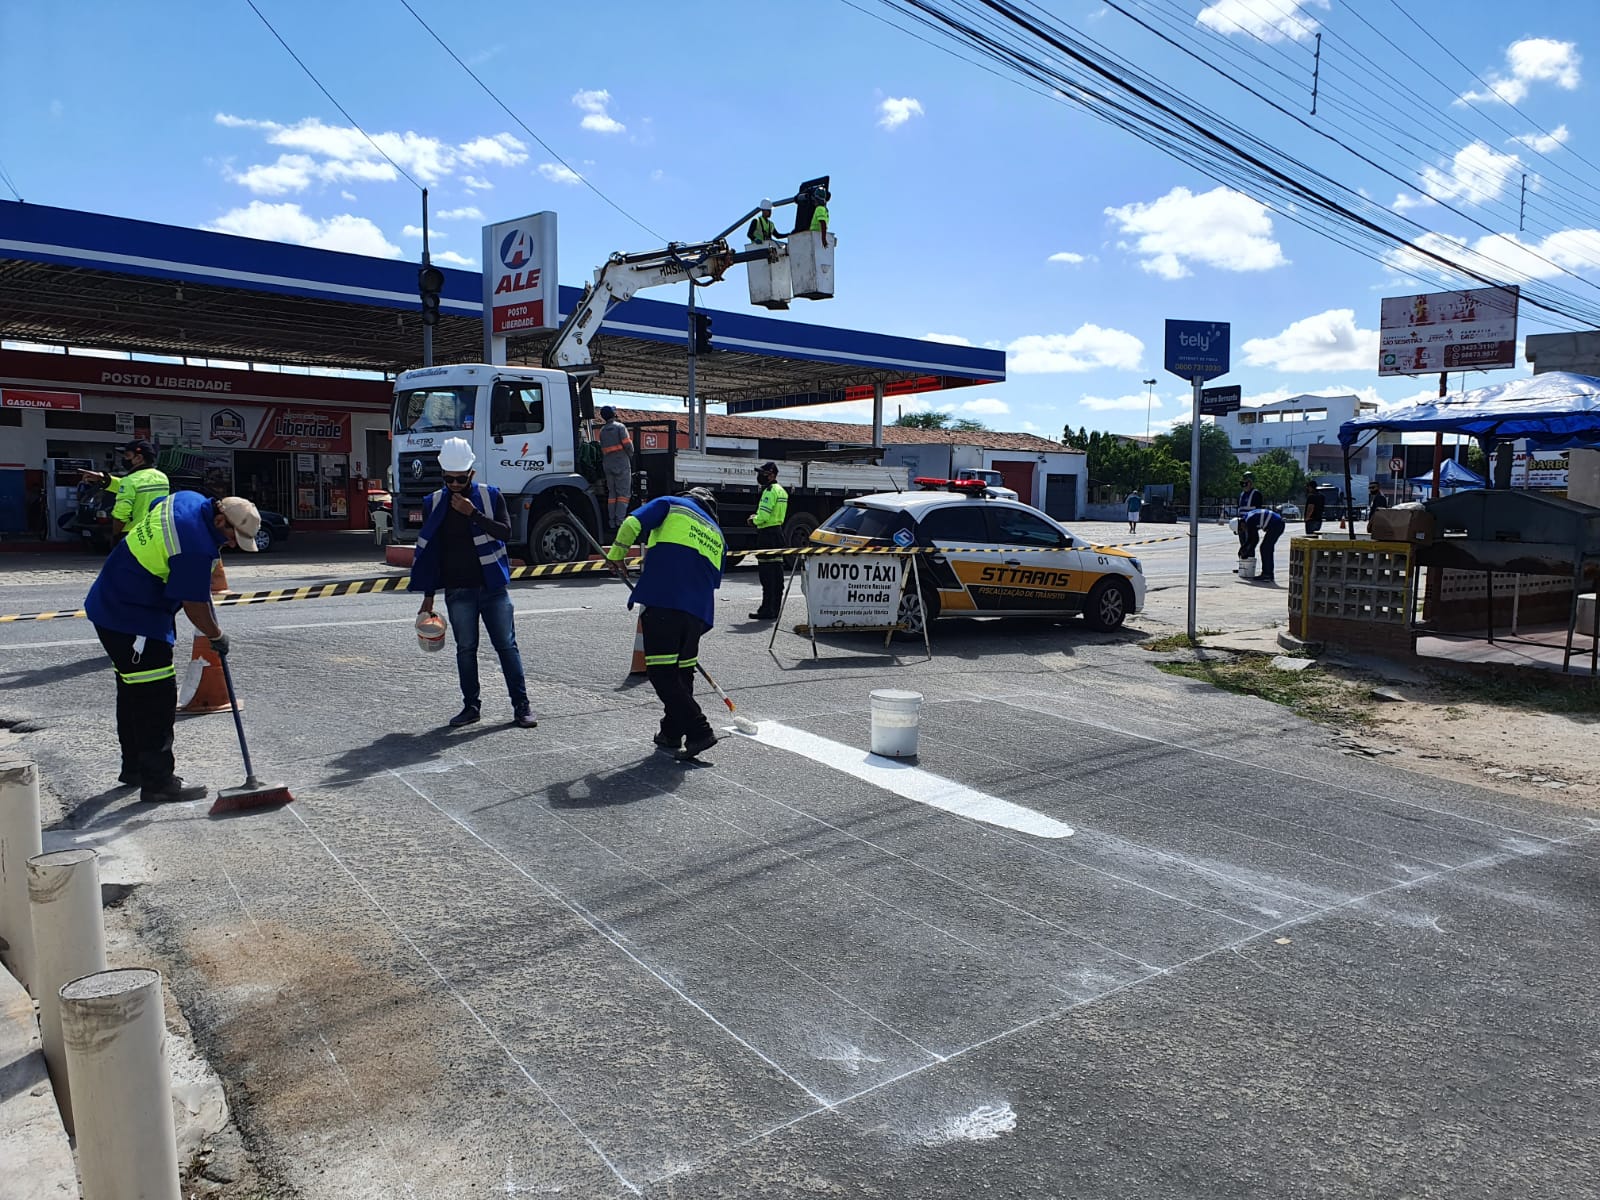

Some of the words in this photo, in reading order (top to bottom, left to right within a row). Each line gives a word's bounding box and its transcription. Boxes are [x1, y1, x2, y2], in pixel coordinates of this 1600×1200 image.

[494, 268, 542, 296] ALE
[507, 306, 528, 317] POSTO
[501, 317, 535, 330] LIBERDADE
[1179, 331, 1210, 352] tely
[101, 372, 151, 386] POSTO
[155, 376, 232, 391] LIBERDADE
[6, 399, 52, 408] GASOLINA
[273, 416, 342, 438] Liberdade
[500, 459, 545, 467] ELETRO
[1097, 556, 1110, 566] 01
[817, 562, 860, 581] MOTO
[863, 561, 896, 582] TÁXI
[980, 566, 1071, 587] STTRANS
[847, 590, 890, 603] Honda
[979, 586, 1025, 597] FISCALIZAÇÃO
